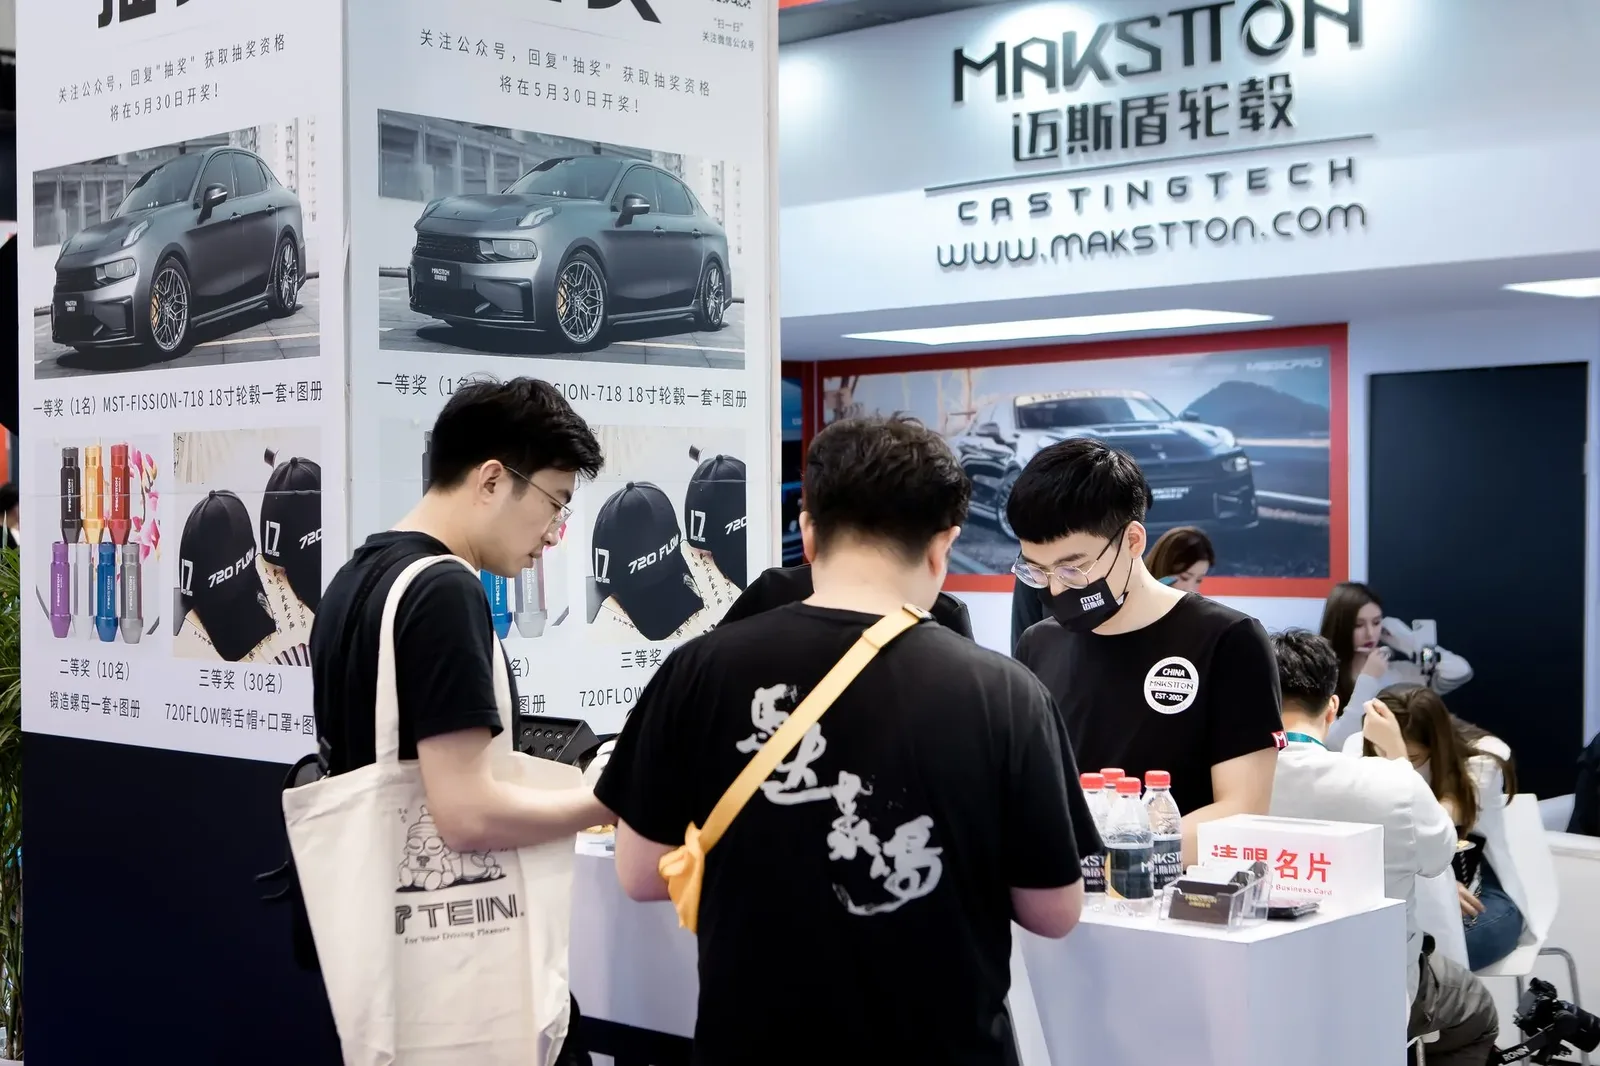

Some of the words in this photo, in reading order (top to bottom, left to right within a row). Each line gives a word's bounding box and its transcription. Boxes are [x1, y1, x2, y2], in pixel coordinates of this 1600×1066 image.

[1012, 73, 1295, 162] 迈斯盾轮毂
[958, 157, 1354, 223] CASTINGTECH
[103, 389, 204, 413] MST-FISSION-718
[209, 380, 322, 407] 18寸轮毂一套+图册
[628, 385, 747, 408] 18寸轮毂一套+图册
[628, 552, 656, 574] 720
[208, 565, 233, 588] 720
[1162, 667, 1185, 677] CHINA
[1275, 883, 1312, 895] Business
[1313, 887, 1333, 896] Card
